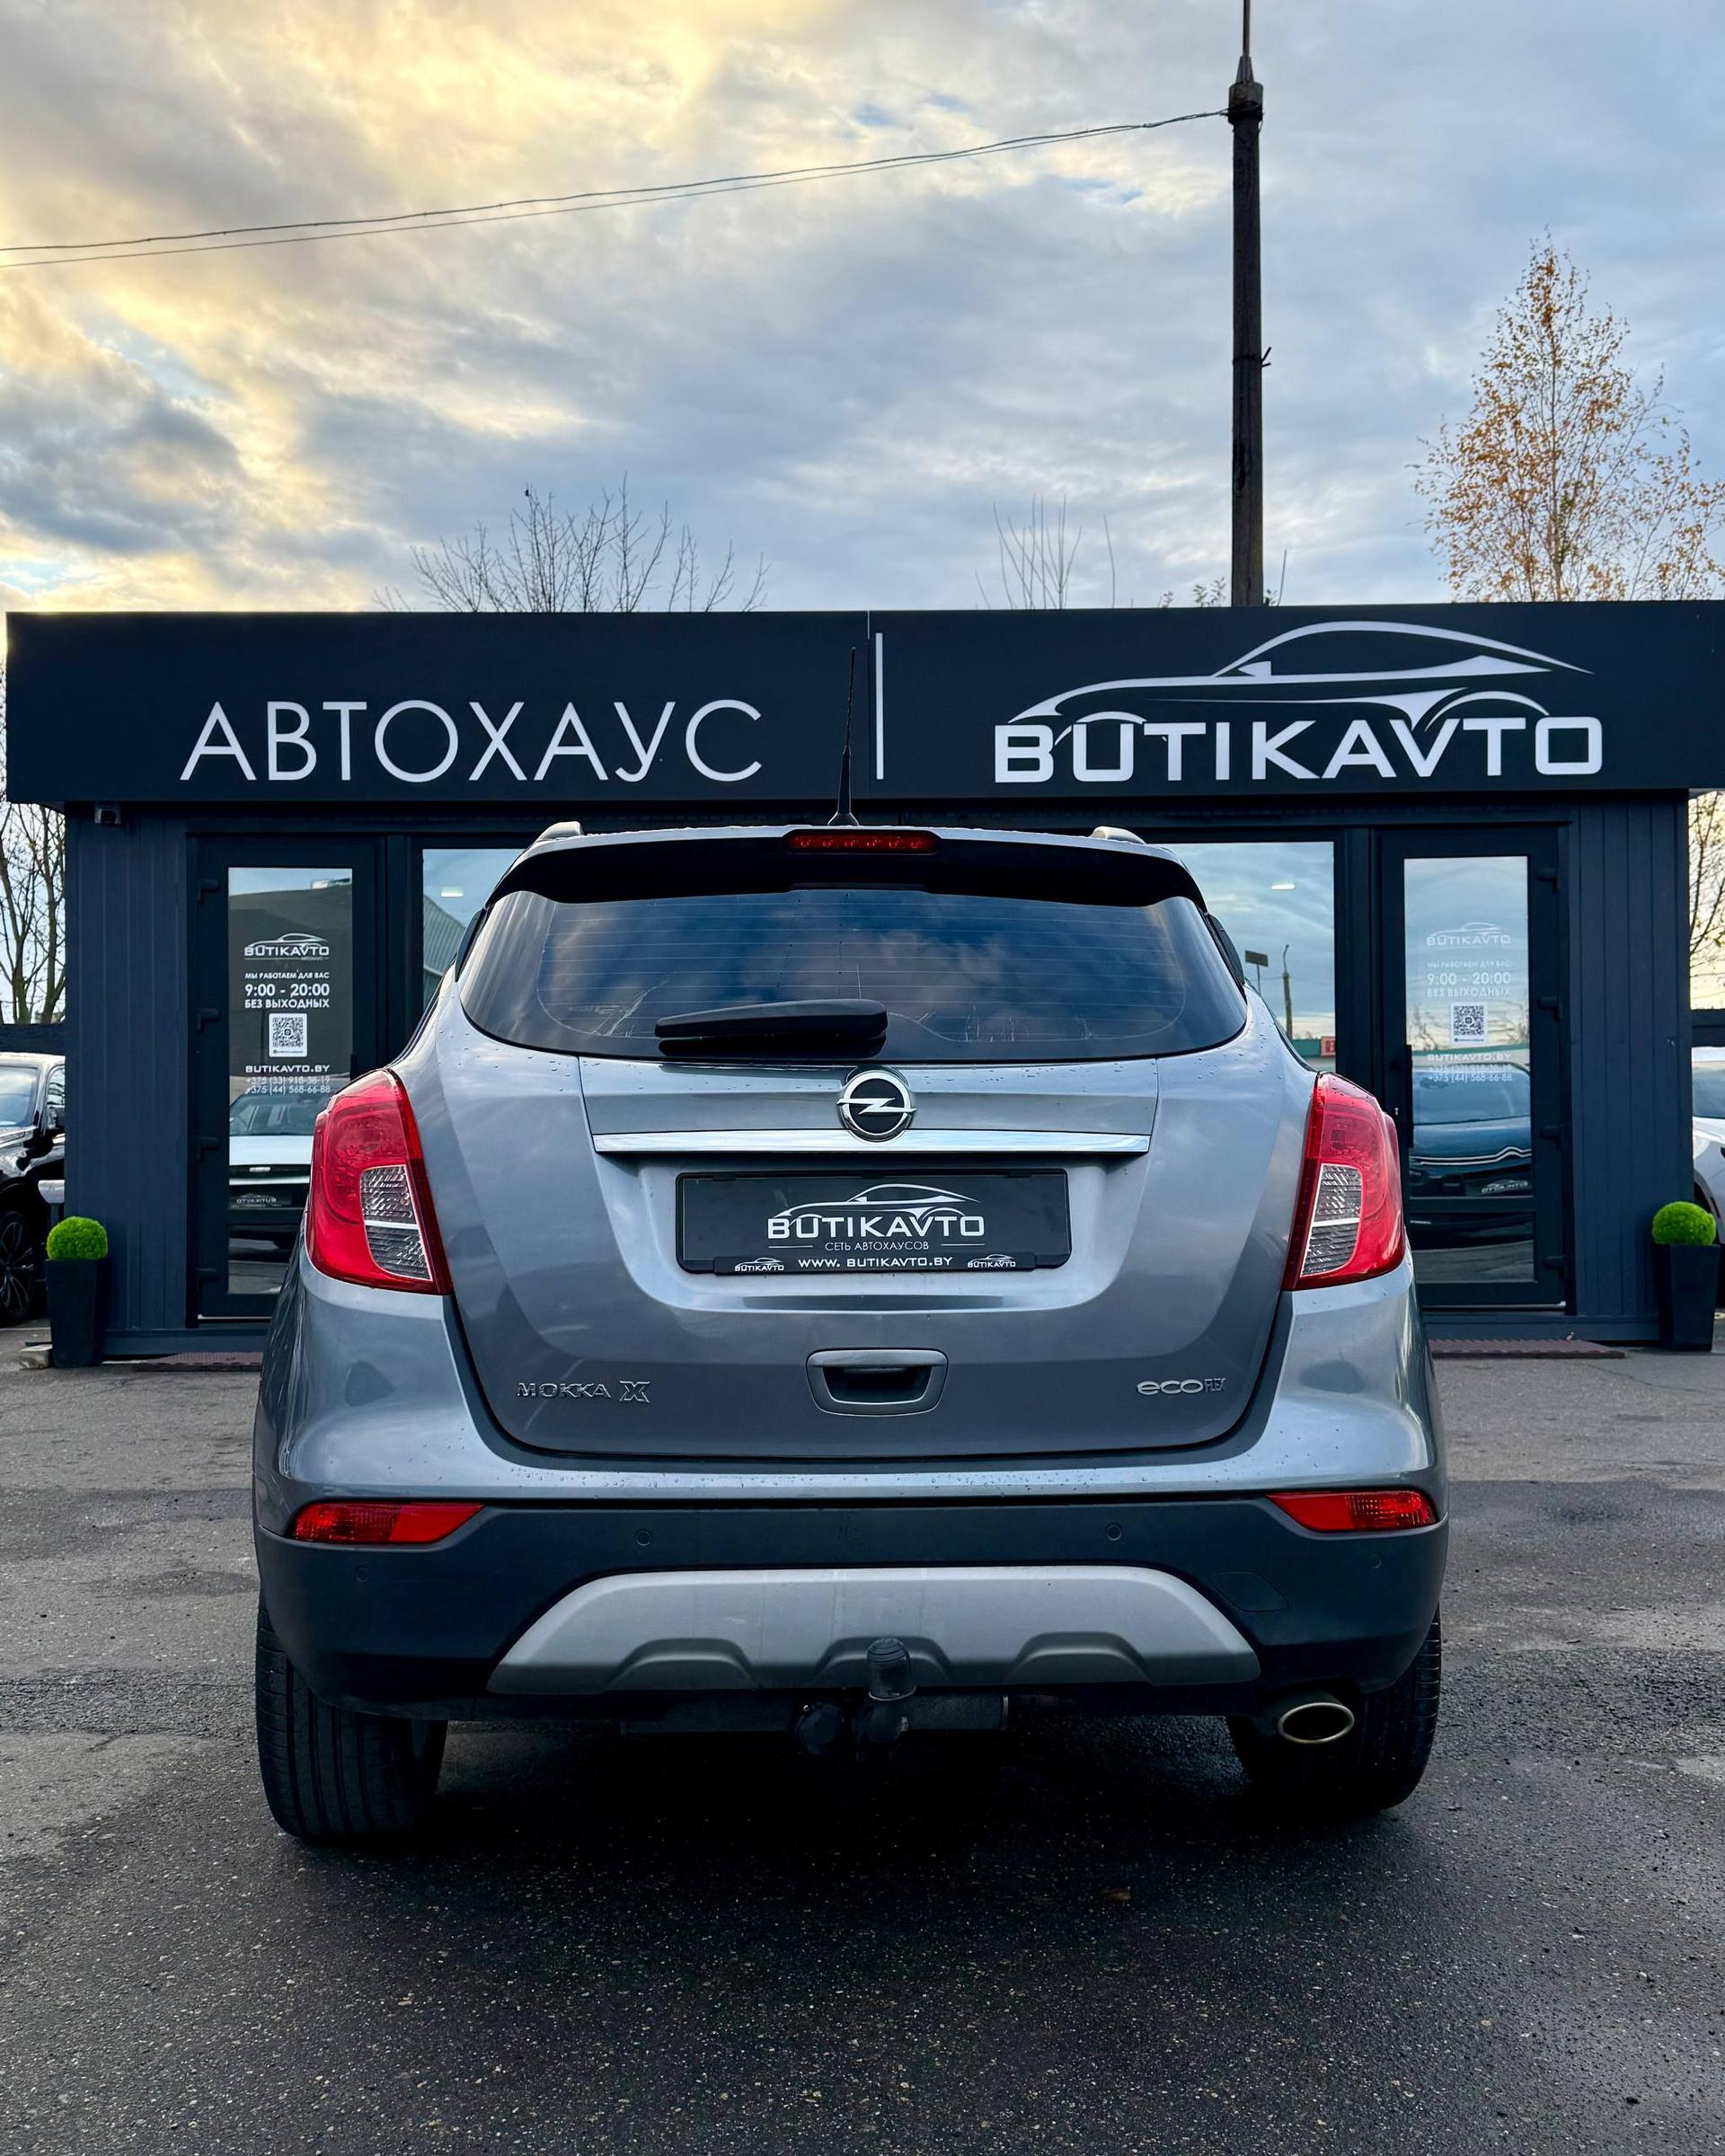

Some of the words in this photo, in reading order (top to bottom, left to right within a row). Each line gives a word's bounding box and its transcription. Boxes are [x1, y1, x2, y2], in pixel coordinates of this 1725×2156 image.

[181, 699, 762, 783] АВТОХАУС
[994, 716, 1604, 783] BUTIKAVTO
[1426, 934, 1510, 946] BUTIKAVTO
[243, 946, 330, 957] BUTIKAVTO
[259, 971, 297, 979] РАБОТАЕМ
[297, 971, 313, 979] ДЛЯ
[314, 971, 330, 979] ВАС
[1427, 973, 1456, 985] 9:00
[1473, 972, 1511, 985] 20:00
[244, 984, 276, 996] 9:00
[290, 983, 331, 996] 20:00
[1447, 987, 1510, 997] ВЫХОДНЫХ
[244, 999, 262, 1009] БЕЗ
[265, 999, 330, 1009] ВЫХОДНЫХ
[245, 1065, 331, 1074] BUTIKAVTO.BY
[270, 1084, 286, 1095] (44)
[288, 1085, 331, 1094] 568-66-88
[767, 1215, 985, 1240] BUTIKAVTO
[825, 1242, 851, 1251] СЕТЬ
[854, 1241, 929, 1250] АВТОХАУСОВ
[734, 1264, 784, 1272] BUTIKAVTO
[798, 1259, 840, 1268] WWW.
[846, 1257, 953, 1268] BUTIKAVTO.BY
[967, 1260, 1016, 1268] BUTIKAVTO
[517, 1383, 612, 1399] MOKKA
[619, 1380, 650, 1402] X
